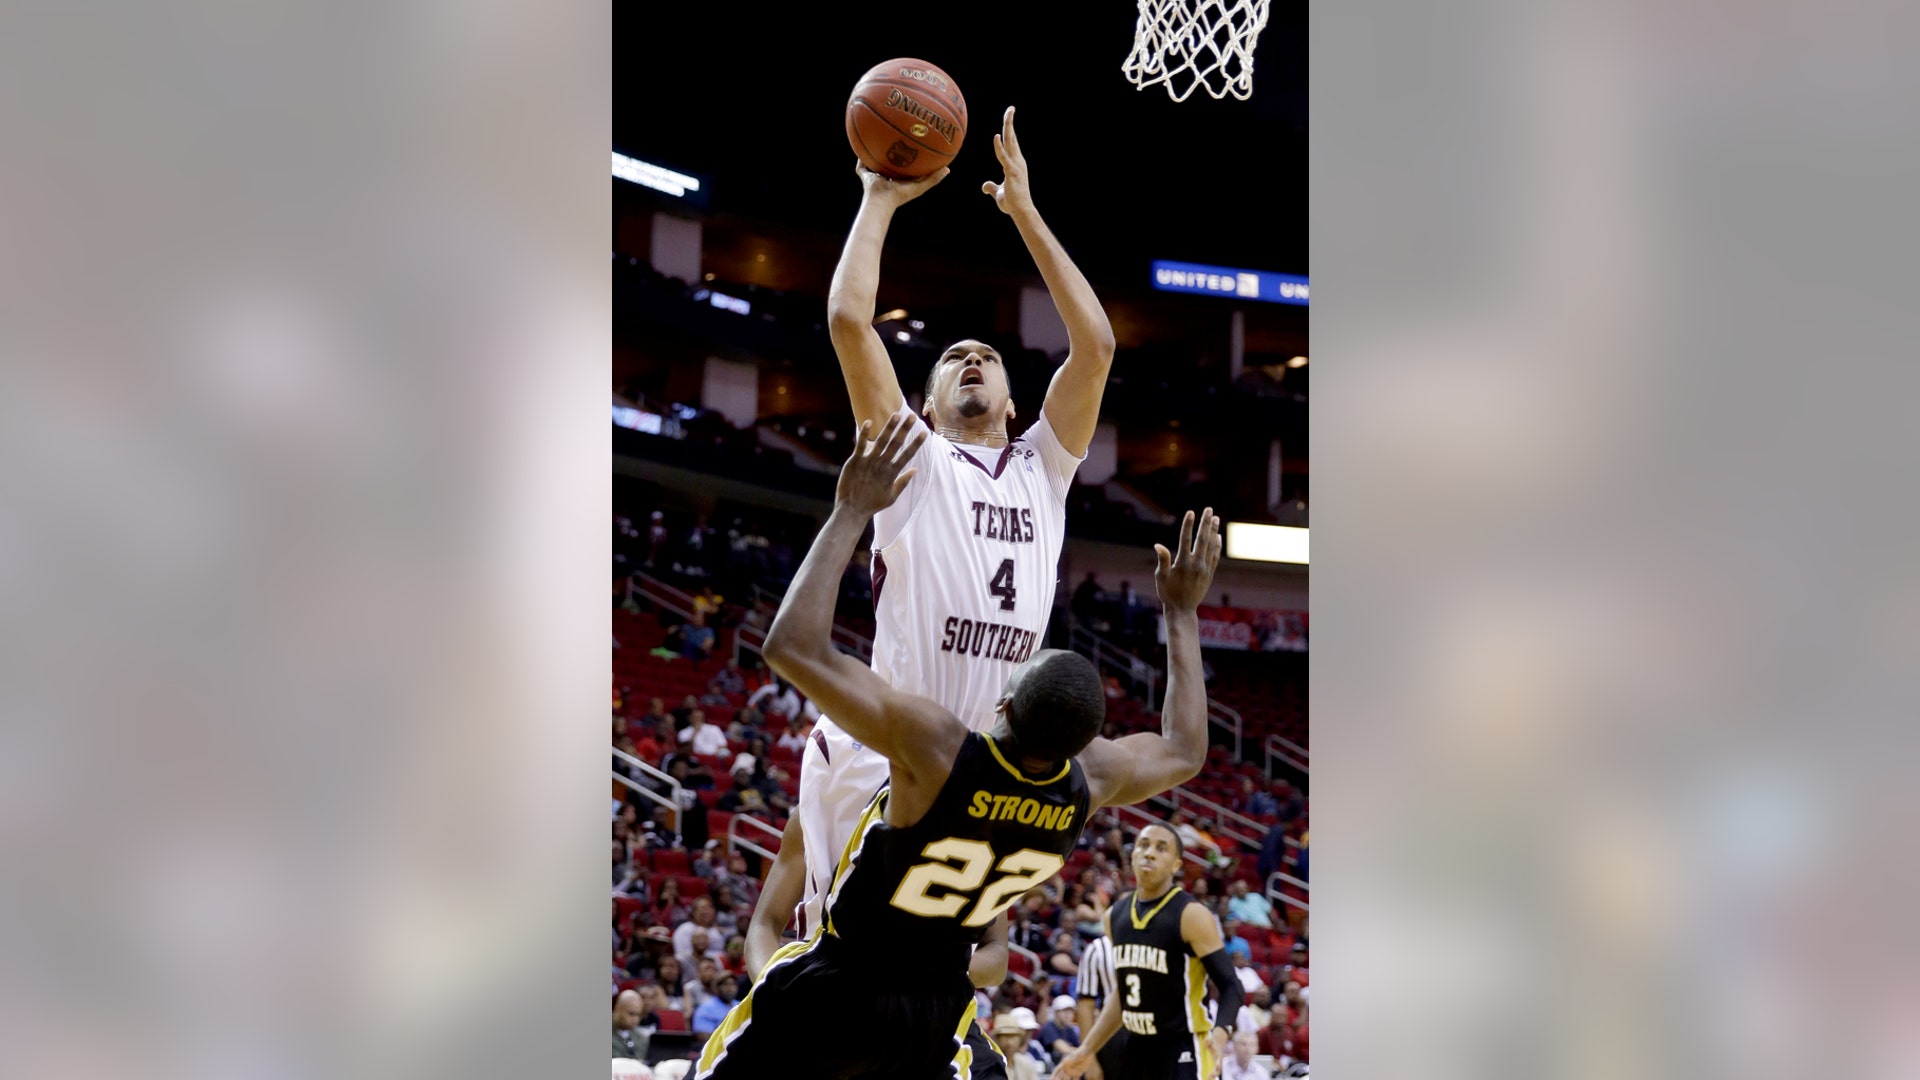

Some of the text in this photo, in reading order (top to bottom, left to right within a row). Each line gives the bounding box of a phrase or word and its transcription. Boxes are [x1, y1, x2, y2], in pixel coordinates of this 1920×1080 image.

[885, 87, 959, 145] SPALDING
[1156, 268, 1236, 292] UNITED
[972, 501, 1034, 543] TEXAS
[989, 558, 1016, 611] 4
[941, 616, 1037, 663] SOUTHERN
[968, 790, 1075, 831] STRONG
[889, 836, 1064, 927] 22
[1125, 973, 1141, 1007] 3
[1122, 1010, 1157, 1035] STATE
